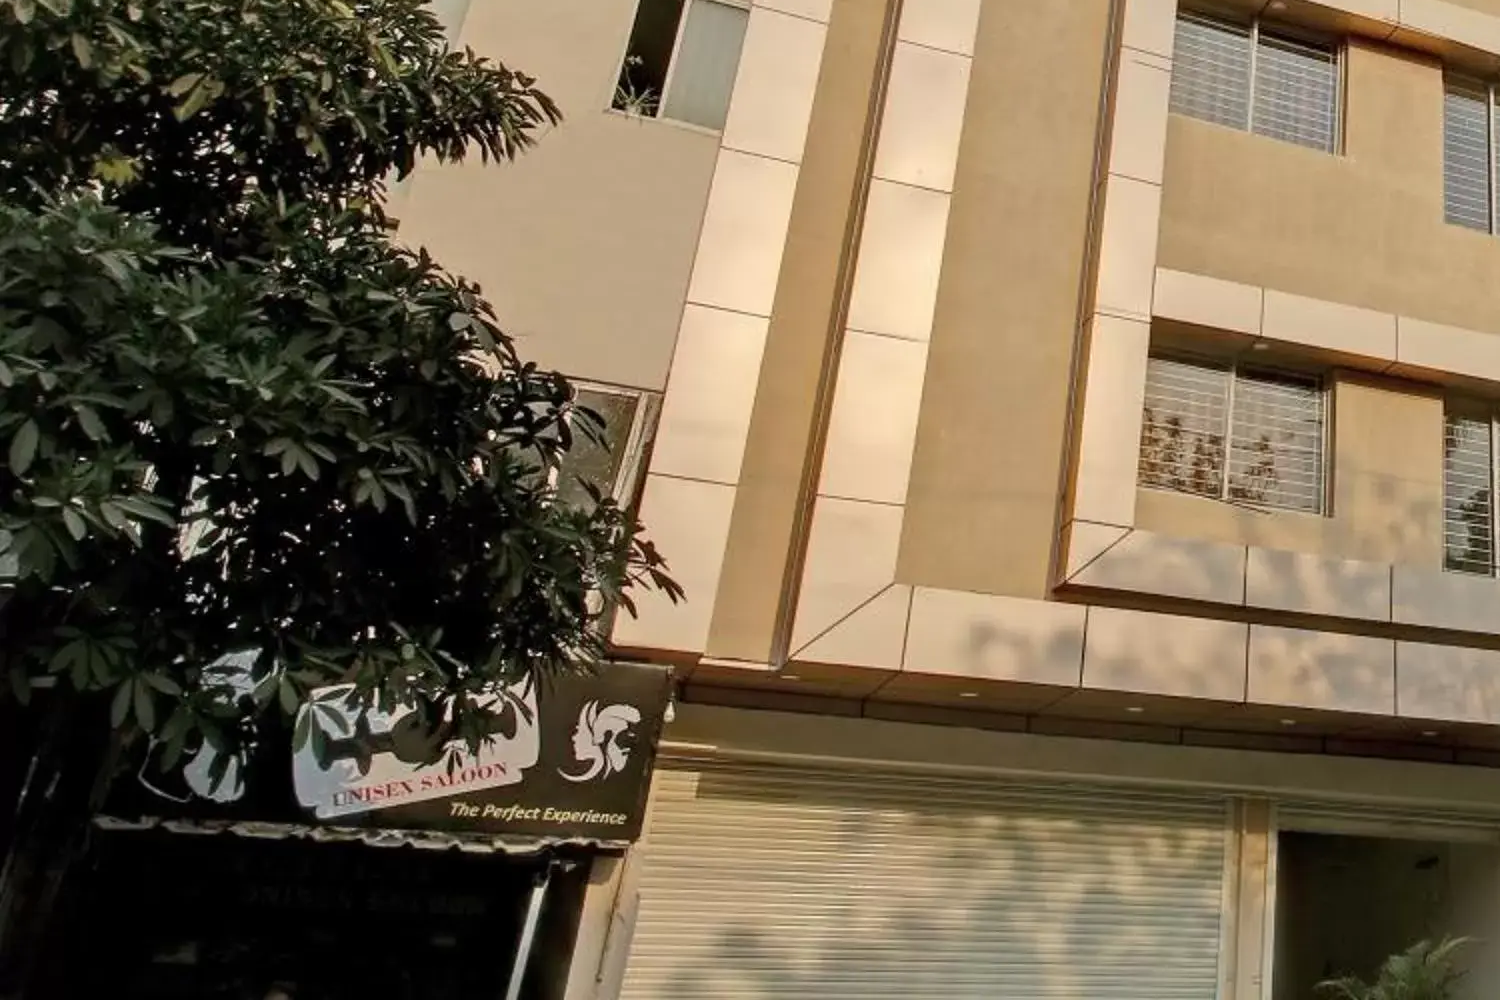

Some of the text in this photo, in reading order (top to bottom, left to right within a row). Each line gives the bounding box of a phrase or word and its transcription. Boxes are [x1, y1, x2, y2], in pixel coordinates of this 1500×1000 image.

[333, 763, 508, 806] UNISEX SALOON
[449, 802, 628, 825] The Perfect Experience
